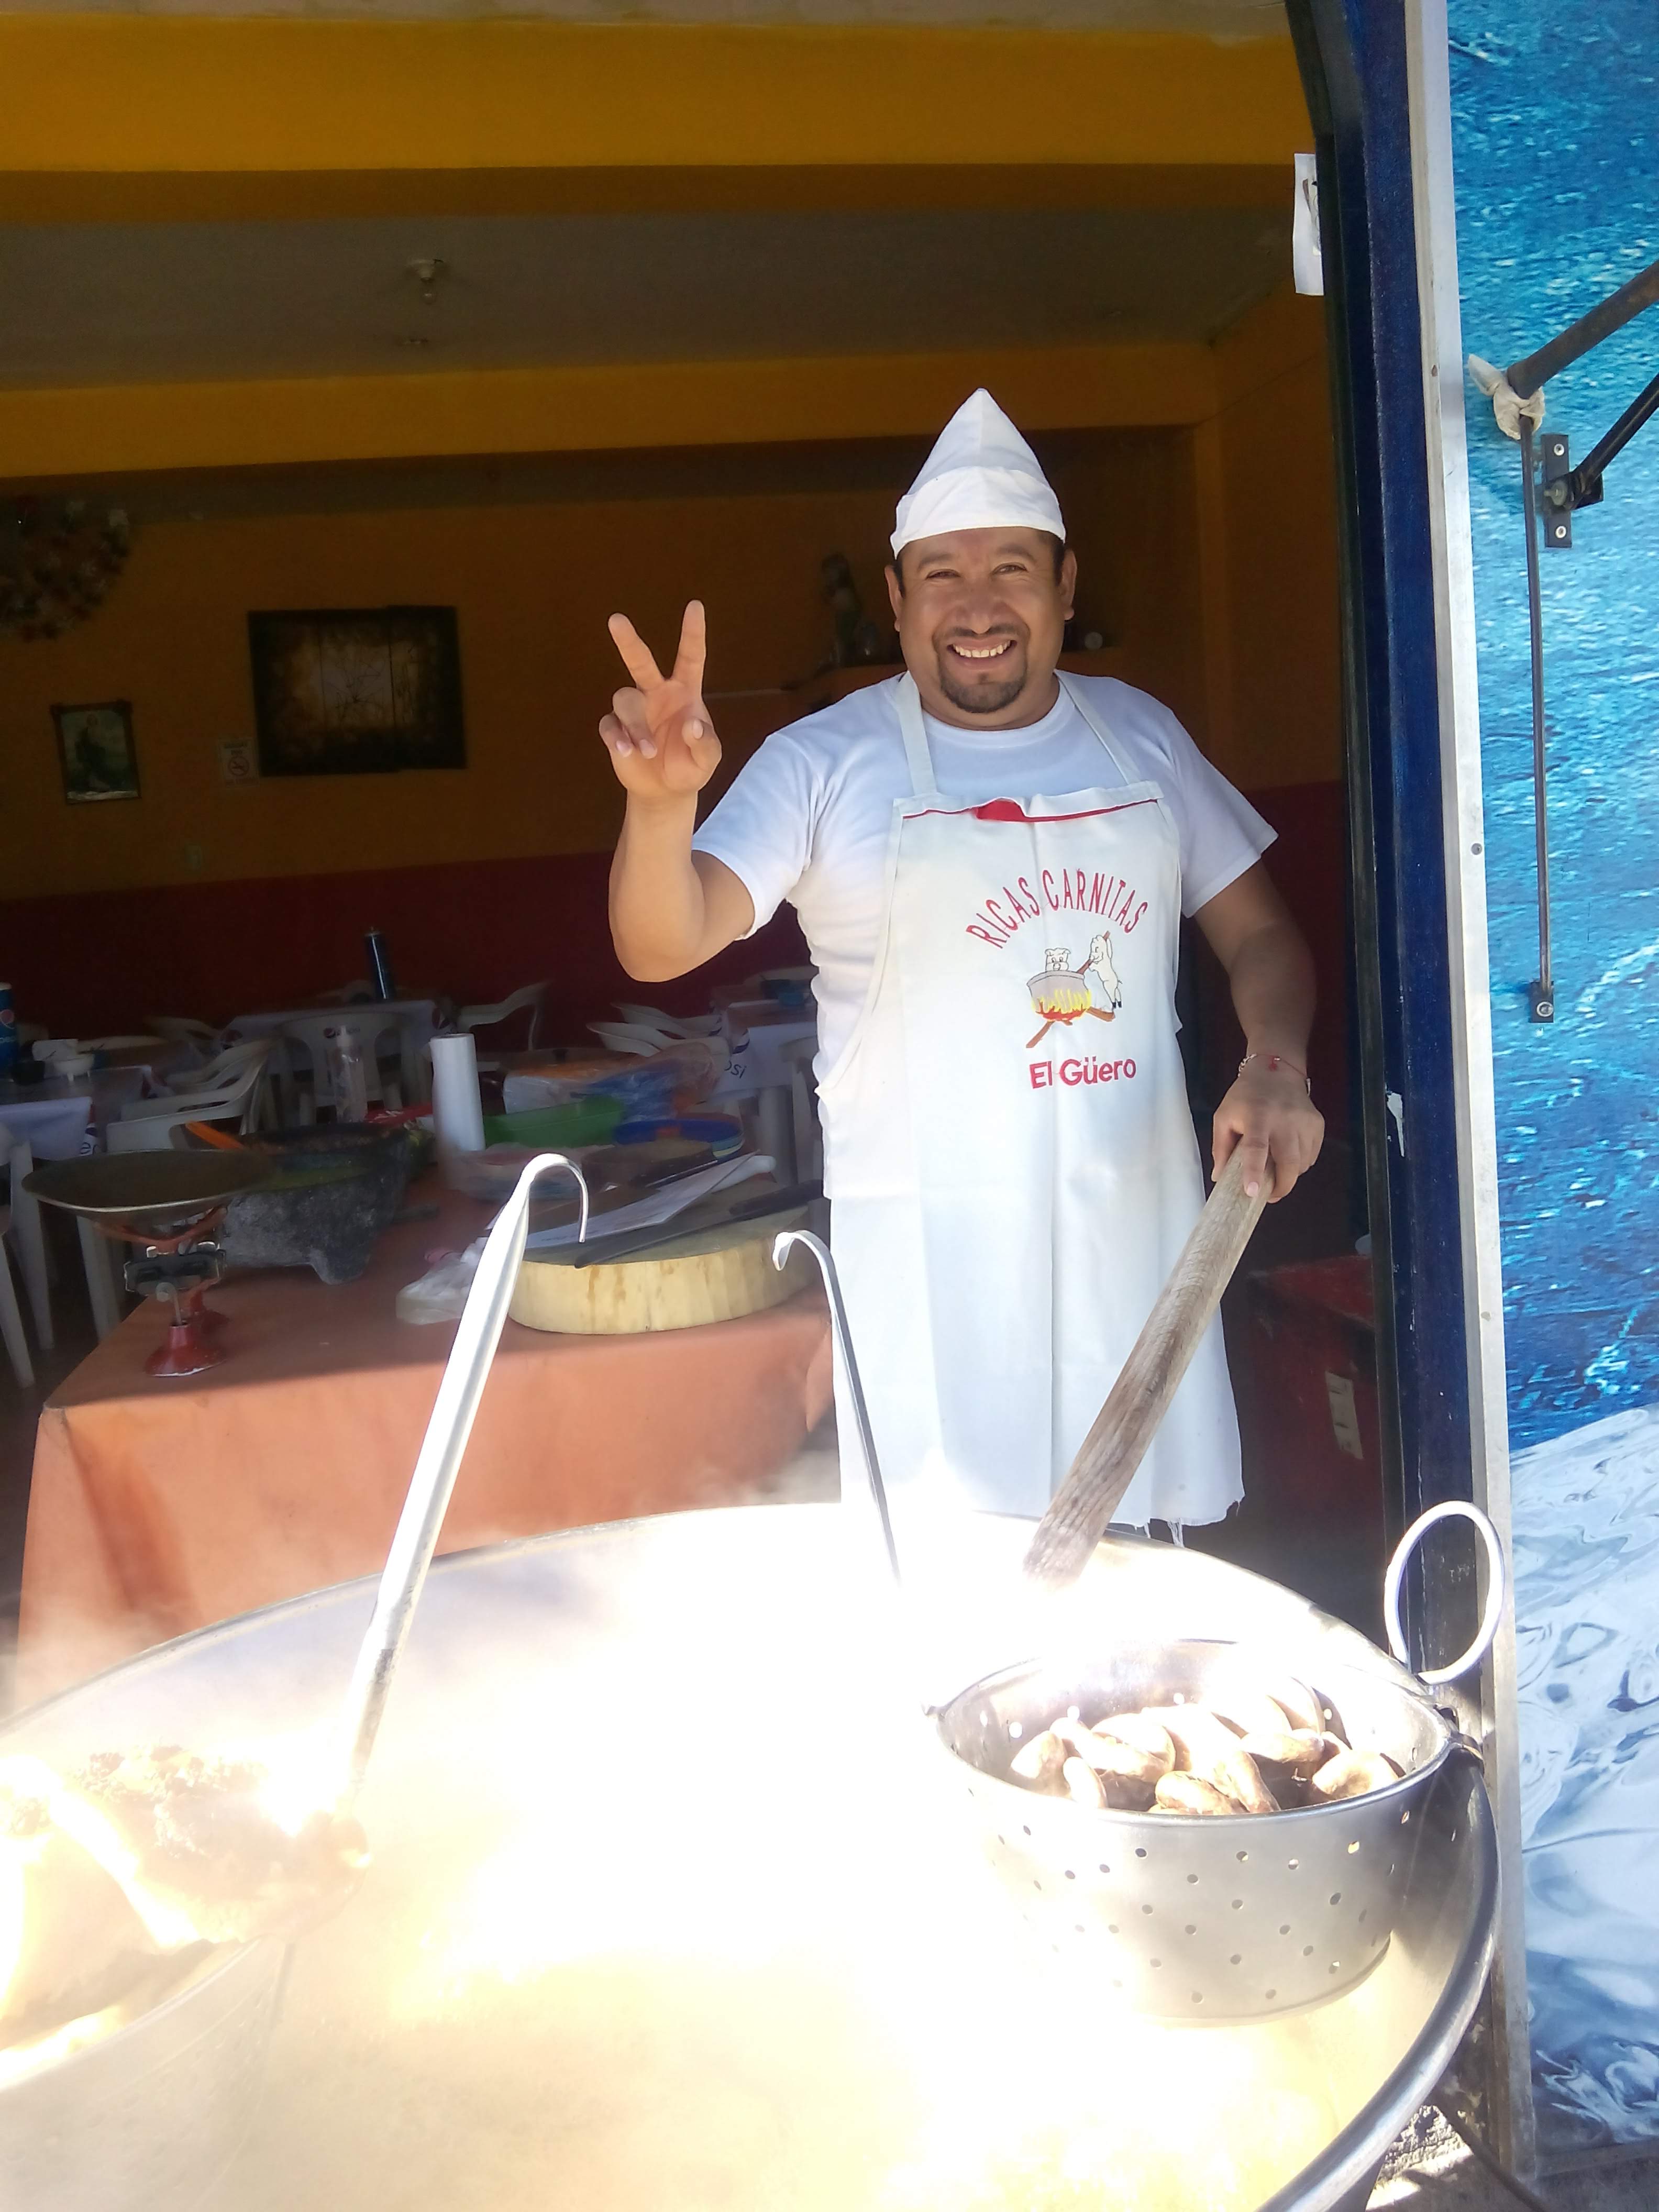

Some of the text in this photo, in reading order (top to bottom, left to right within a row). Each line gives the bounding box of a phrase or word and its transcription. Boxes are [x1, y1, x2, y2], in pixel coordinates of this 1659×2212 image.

[966, 869, 1148, 949] RICAS CARNITAS
[1030, 1056, 1136, 1089] El Güero
